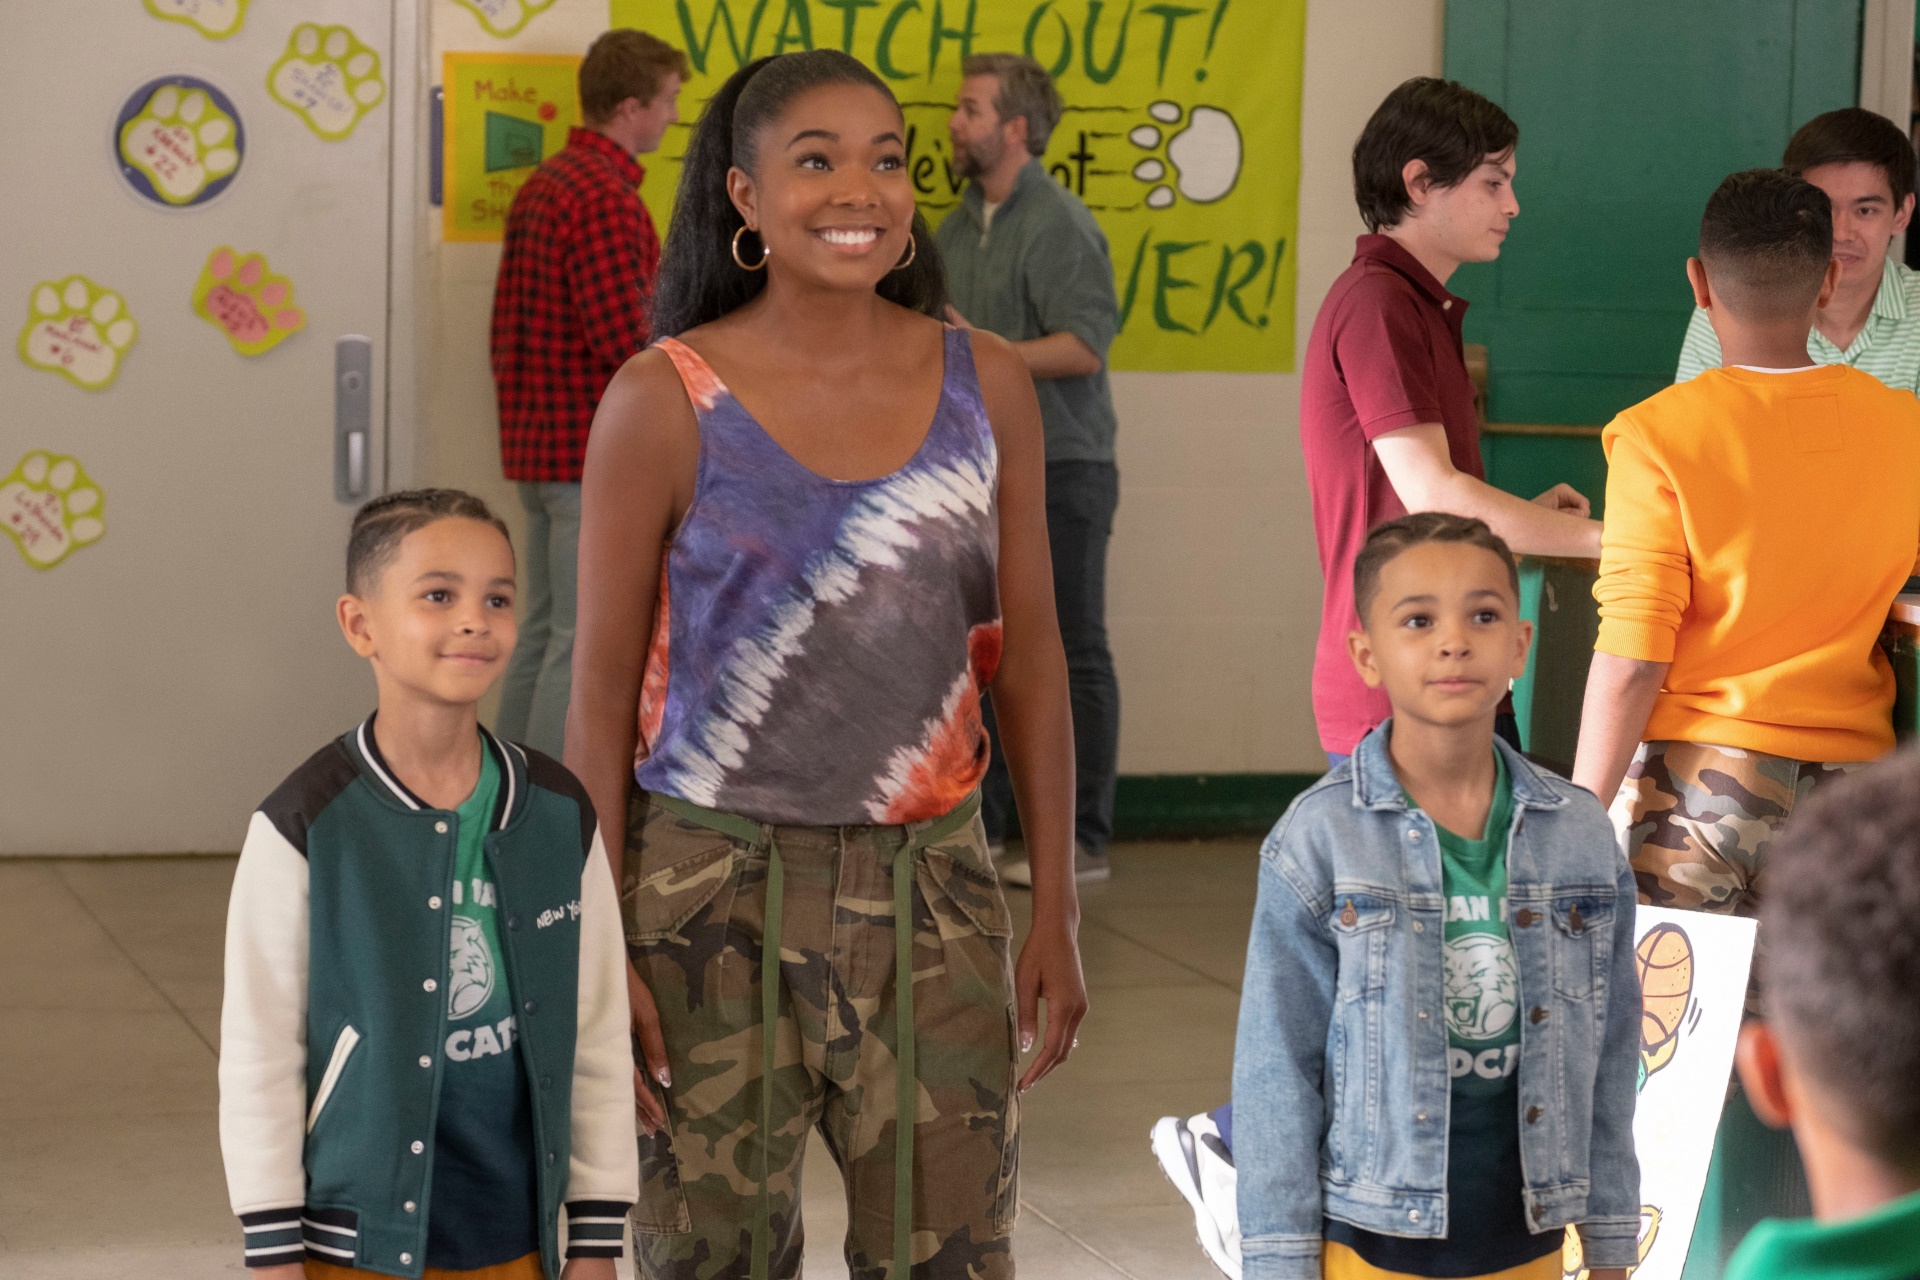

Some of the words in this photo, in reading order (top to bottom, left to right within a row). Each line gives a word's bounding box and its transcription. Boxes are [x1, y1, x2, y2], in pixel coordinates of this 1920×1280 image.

[675, 0, 980, 84] WATCH
[1022, 0, 1230, 88] OUT!
[474, 78, 537, 104] Make
[536, 905, 565, 929] NEW
[445, 1014, 519, 1062] CAT
